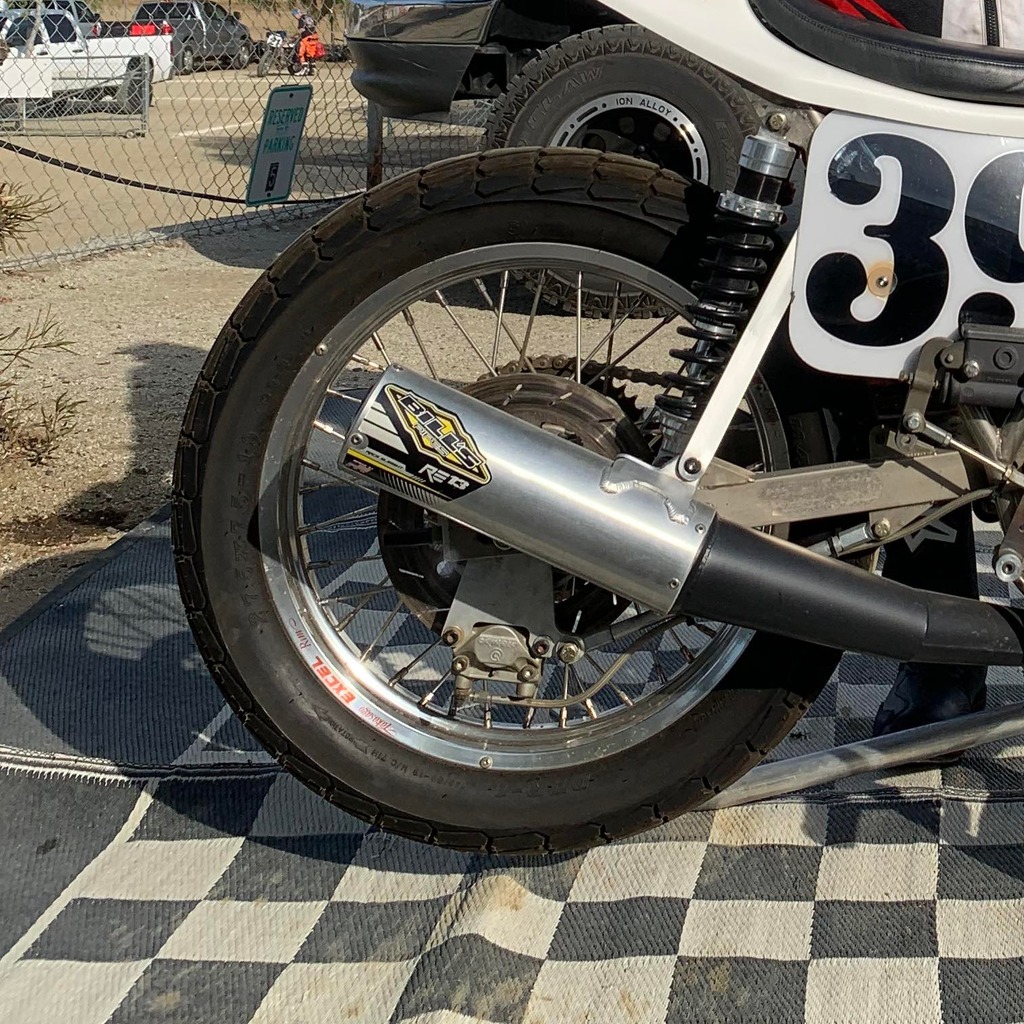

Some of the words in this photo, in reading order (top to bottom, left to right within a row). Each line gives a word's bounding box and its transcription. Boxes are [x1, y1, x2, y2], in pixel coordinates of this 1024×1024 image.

[268, 107, 304, 125] RESERVED
[615, 97, 633, 106] ION
[639, 98, 672, 116] ALLOY
[263, 136, 296, 153] PARKING
[398, 392, 482, 469] BILL'S
[310, 656, 357, 704] EXCEL
